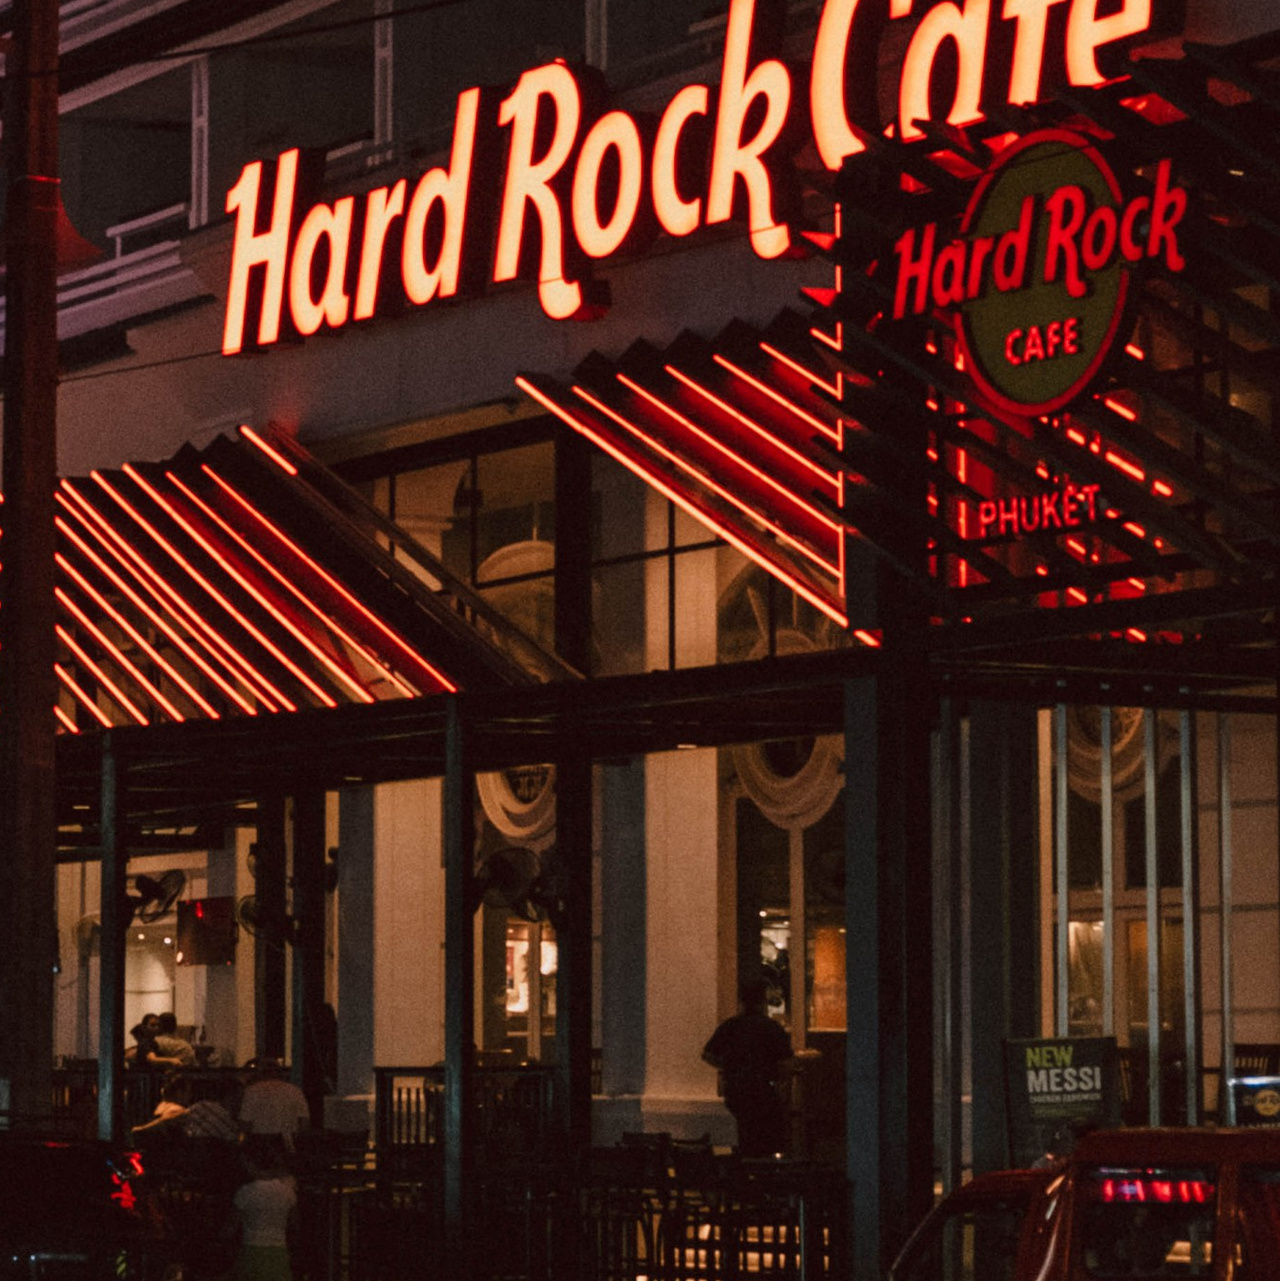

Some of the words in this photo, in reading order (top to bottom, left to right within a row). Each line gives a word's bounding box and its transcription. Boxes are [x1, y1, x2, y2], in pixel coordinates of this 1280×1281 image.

[222, 86, 480, 355] Hard
[892, 194, 1036, 320] Hard
[1043, 158, 1188, 299] Rock
[1004, 317, 1079, 366] CAFE
[978, 483, 1102, 538] PHUKET
[1026, 1045, 1074, 1068] NEW
[1027, 1066, 1102, 1093] MESSI
